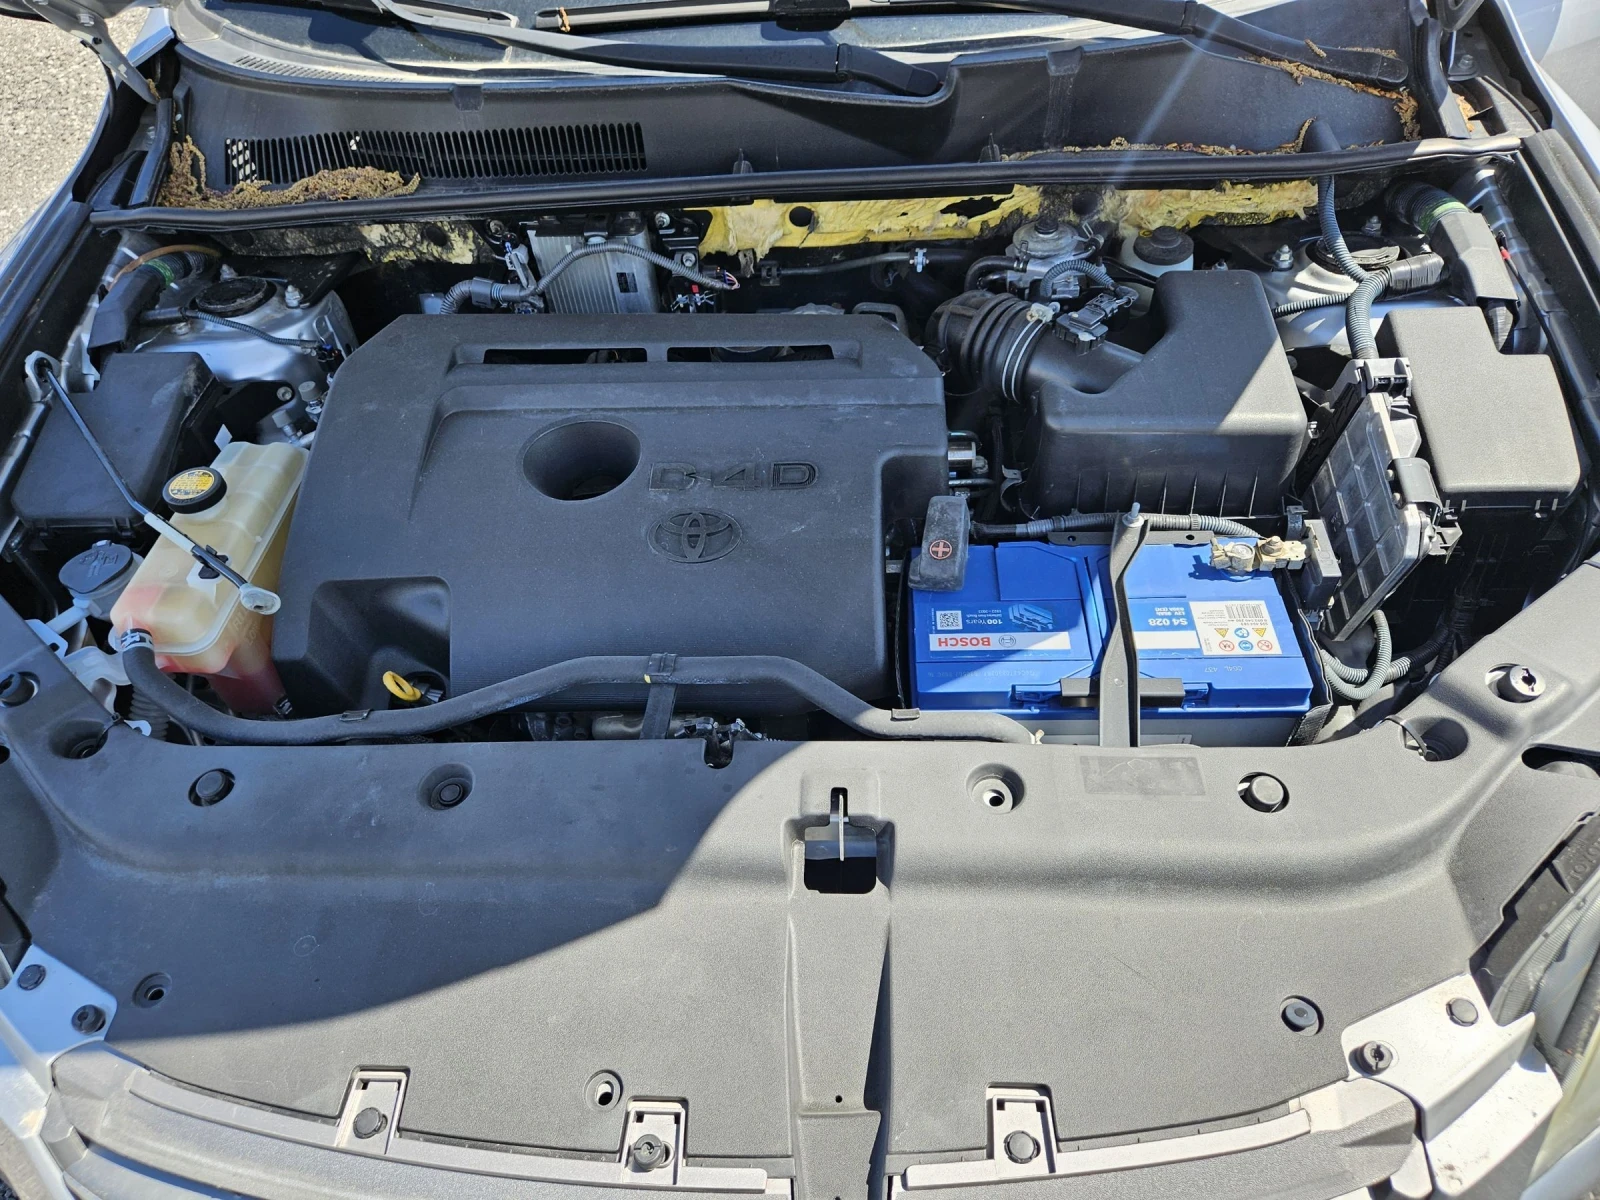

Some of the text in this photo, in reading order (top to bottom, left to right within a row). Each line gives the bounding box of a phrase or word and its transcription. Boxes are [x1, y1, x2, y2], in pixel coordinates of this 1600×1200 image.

[1148, 617, 1170, 626] 028
[1172, 618, 1188, 626] S4
[937, 636, 991, 647] BOSCH
